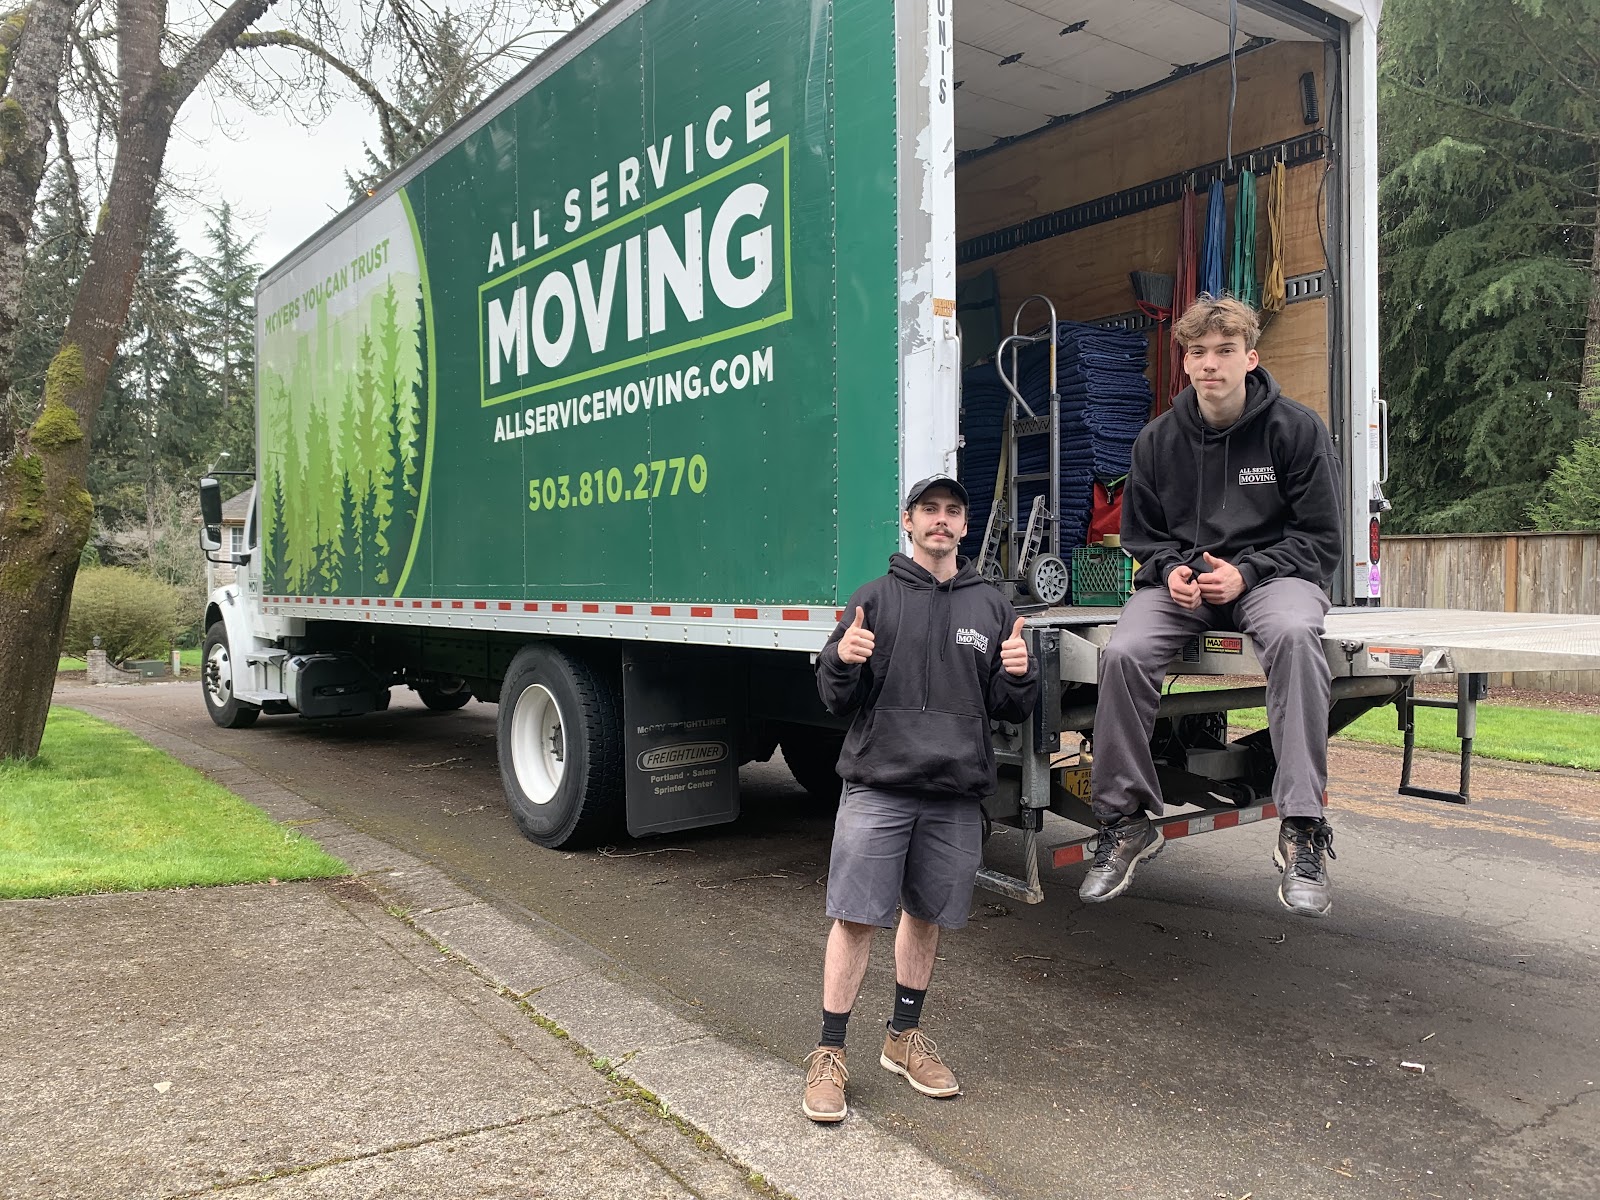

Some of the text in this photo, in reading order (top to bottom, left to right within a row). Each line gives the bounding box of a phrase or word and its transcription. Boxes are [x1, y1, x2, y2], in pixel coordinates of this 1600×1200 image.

[487, 80, 772, 273] ALL SERVICE
[264, 238, 390, 337] MOVERS YOU CAN TRUST
[487, 182, 773, 386] MOVING
[494, 346, 774, 443] ALLSERVICEMOVING.COM
[528, 454, 708, 512] 503.810.2770
[1241, 474, 1275, 482] MOVING
[958, 635, 987, 651] MOVING
[646, 746, 719, 766] FREIGHTLINER
[650, 768, 717, 783] Portland Salem
[654, 780, 714, 796] Sprinter Center
